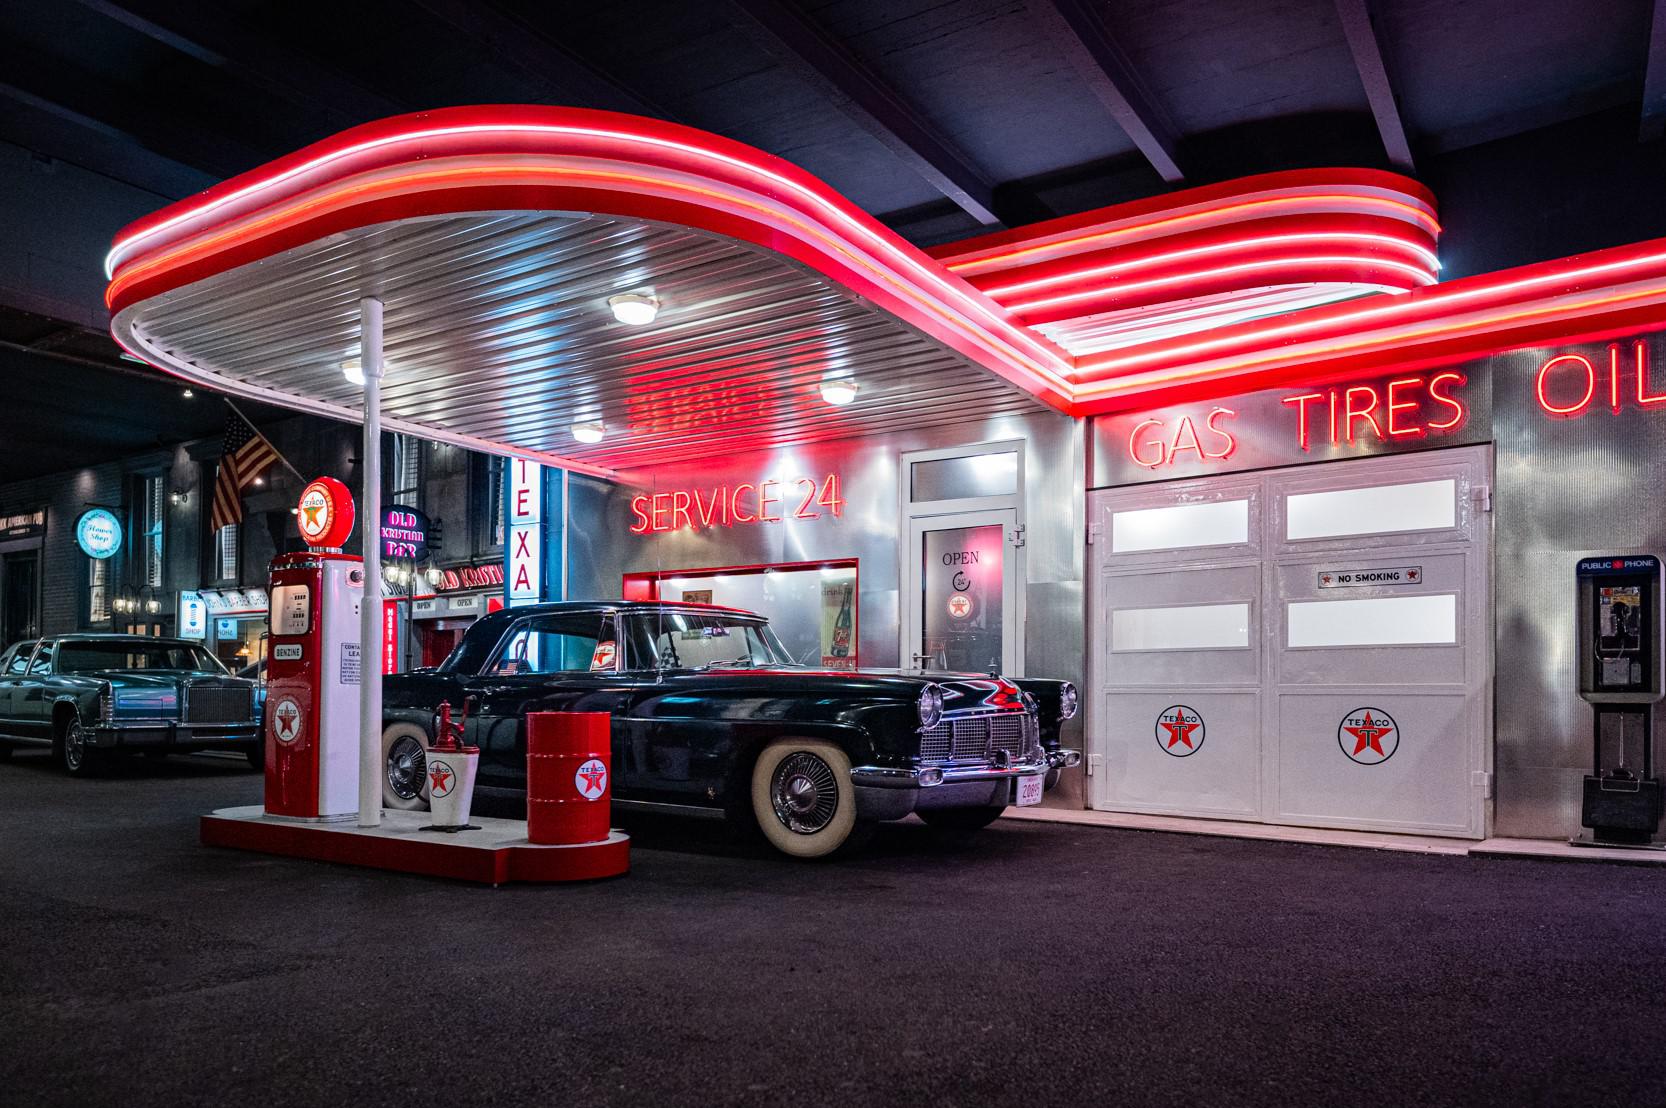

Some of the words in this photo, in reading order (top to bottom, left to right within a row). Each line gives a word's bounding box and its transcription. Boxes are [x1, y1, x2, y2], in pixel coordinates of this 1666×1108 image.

[1128, 407, 1236, 468] GAS
[1284, 372, 1468, 449] TIRES
[1536, 342, 1666, 416] OIL
[630, 480, 782, 534] SERVICE
[792, 472, 845, 520] 24
[942, 551, 980, 566] OPEN
[1582, 561, 1612, 570] PUBLIC
[1624, 560, 1654, 568] PHONE
[1338, 575, 1352, 583] NO
[1355, 572, 1400, 582] SMOKING
[417, 601, 431, 610] OPEN
[457, 598, 473, 608] OPEN
[276, 648, 300, 657] BENZINE
[1163, 715, 1198, 723] TEXACO
[1347, 718, 1390, 727] TEXACO
